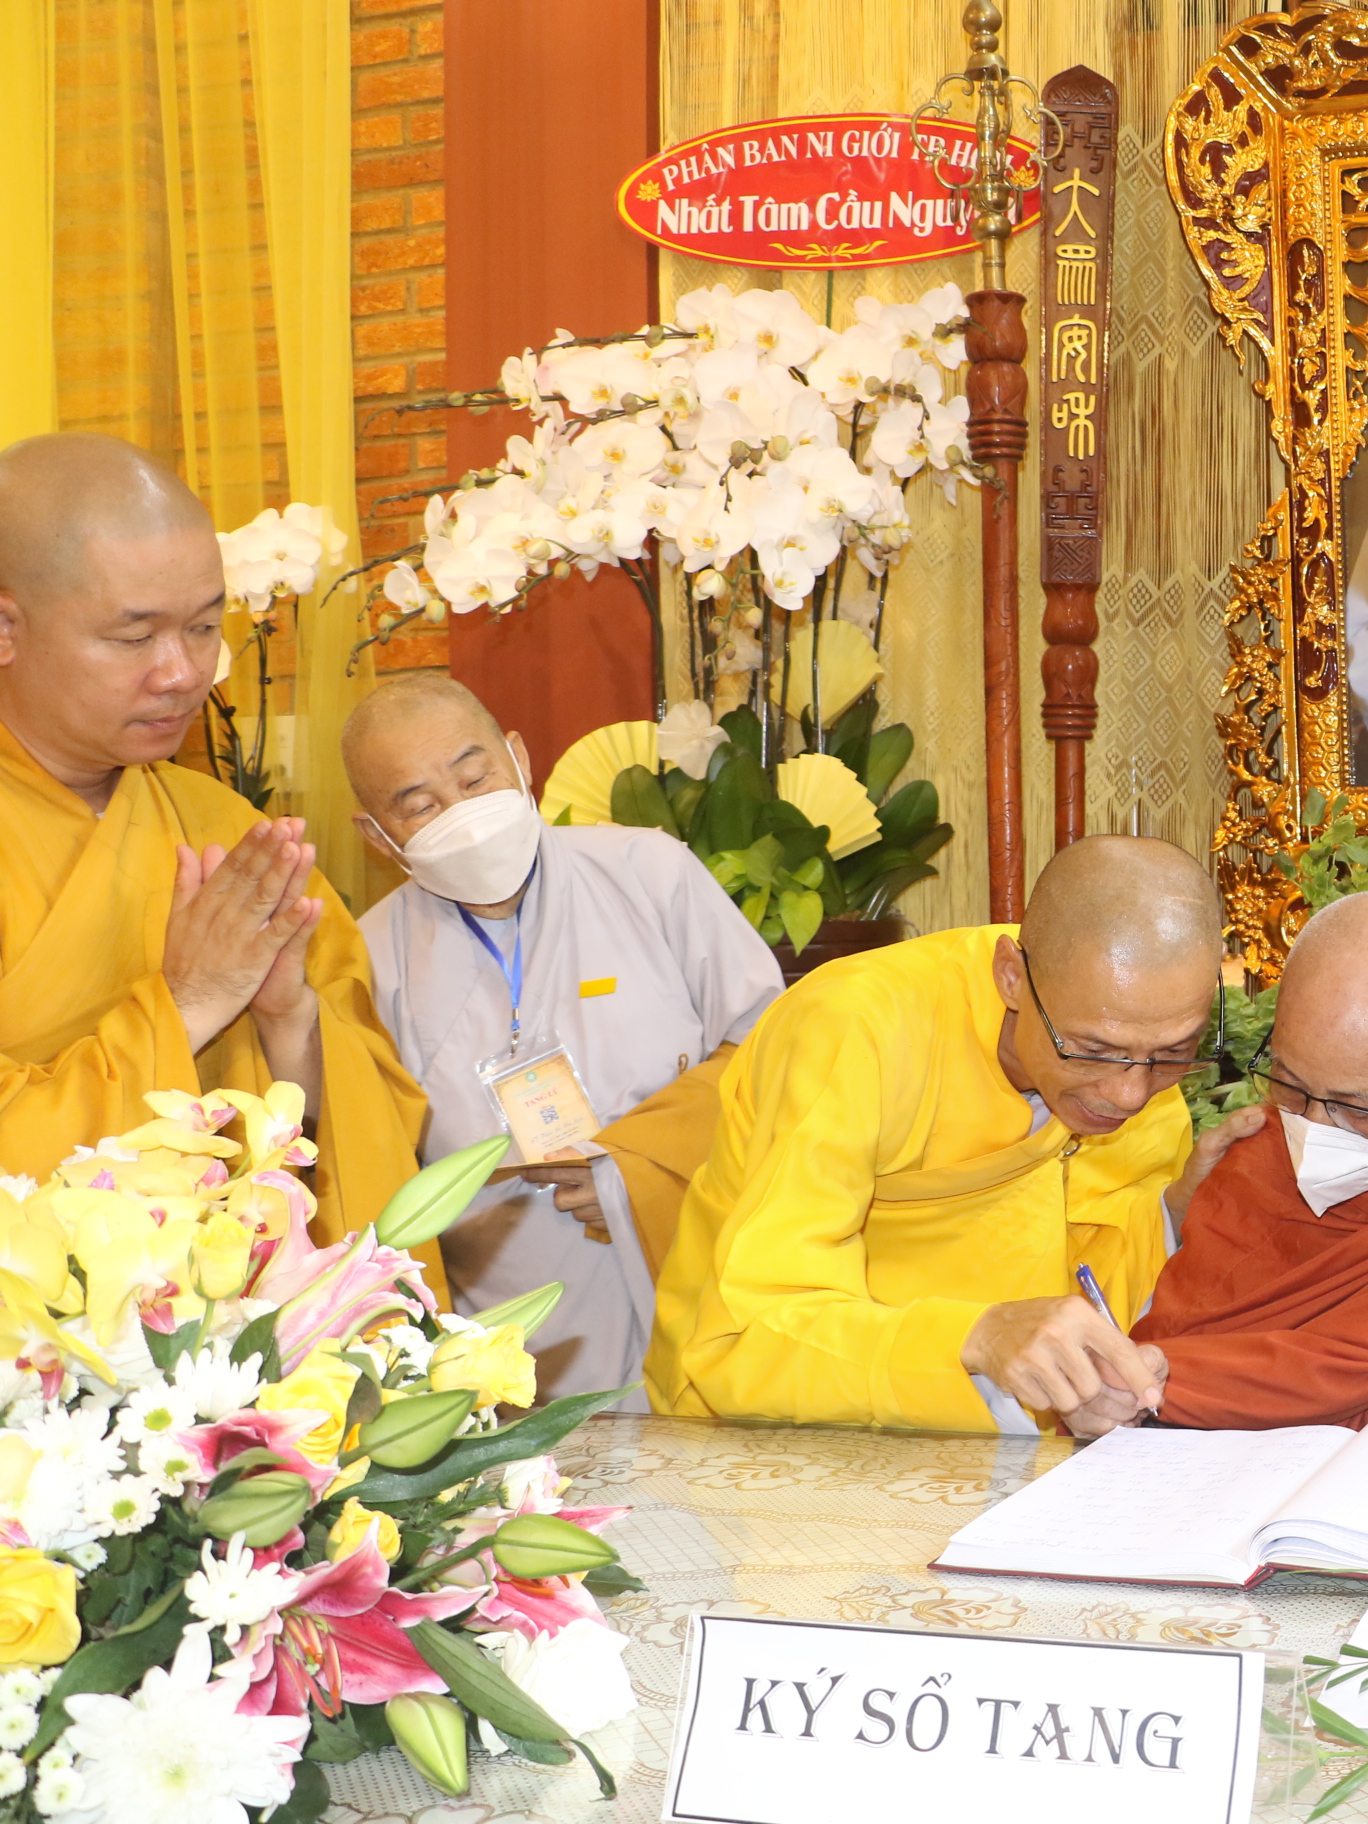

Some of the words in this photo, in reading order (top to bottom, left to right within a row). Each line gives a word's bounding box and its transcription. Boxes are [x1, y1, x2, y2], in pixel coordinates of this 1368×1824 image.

[662, 143, 735, 191] PHÂN
[743, 133, 799, 167] BAN
[806, 131, 834, 158] NI
[841, 122, 901, 158] GIỚI
[657, 193, 733, 235] Nhất
[739, 195, 809, 232] Tâm
[816, 189, 882, 230] Cầu
[737, 1667, 846, 1738] KÝ
[854, 1672, 951, 1753] SỔ
[976, 1697, 1185, 1770] TANG
